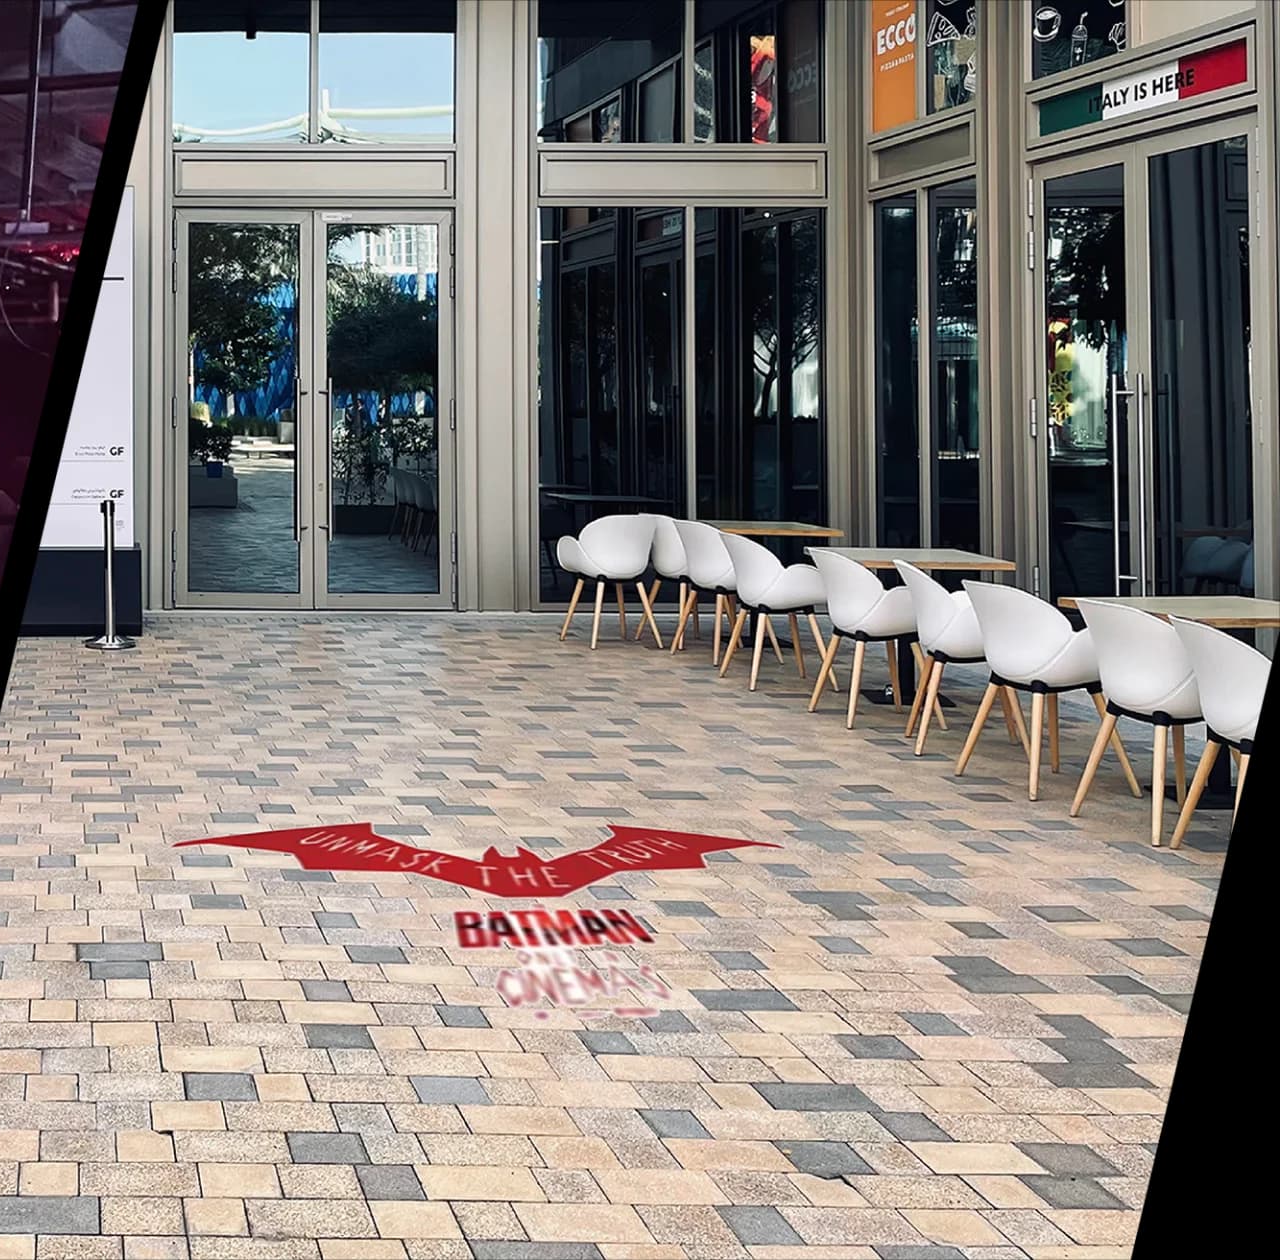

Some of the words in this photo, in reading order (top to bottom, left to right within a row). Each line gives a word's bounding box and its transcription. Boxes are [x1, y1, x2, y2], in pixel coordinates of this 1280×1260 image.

[877, 13, 916, 55] ECCO
[1089, 86, 1129, 114] ITALY
[1134, 82, 1147, 101] IS
[1152, 68, 1195, 96] HERE
[109, 446, 124, 456] GF
[109, 489, 124, 499] GF
[300, 831, 453, 874] UNMASK
[474, 865, 572, 888] THE
[579, 836, 688, 869] TRUTH
[454, 908, 656, 949] BATMAN
